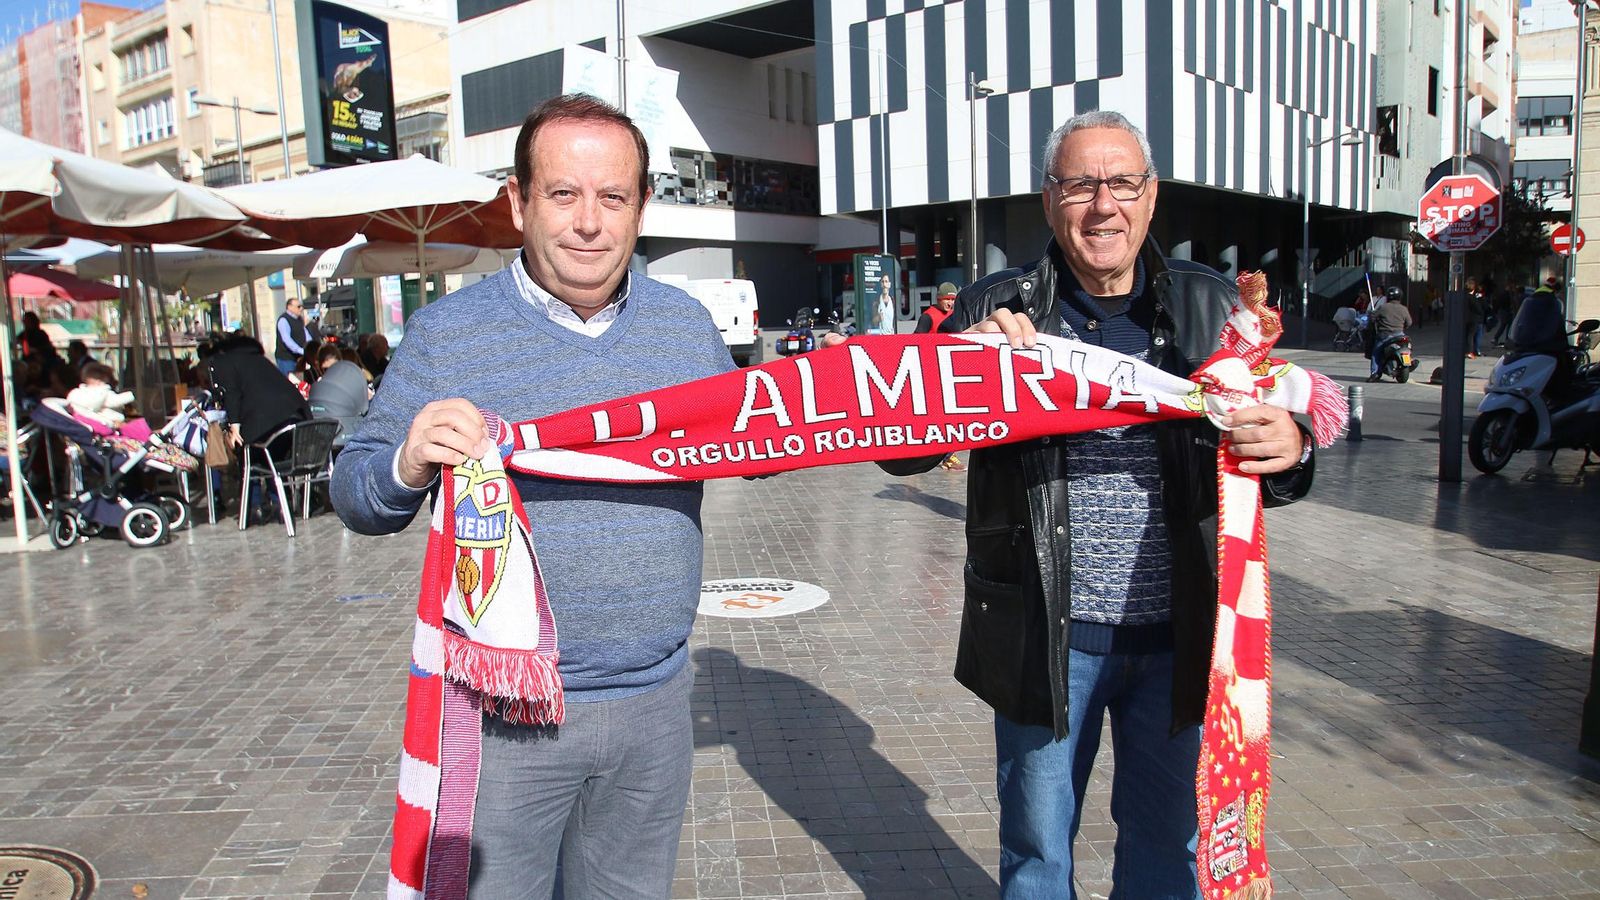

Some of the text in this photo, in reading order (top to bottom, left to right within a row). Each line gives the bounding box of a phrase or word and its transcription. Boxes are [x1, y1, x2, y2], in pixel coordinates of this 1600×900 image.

[332, 100, 357, 121] 15%
[1426, 204, 1494, 222] STOP
[732, 343, 1160, 433] ALMERIA
[651, 421, 1010, 468] ORGULLO ROJIBLANCO
[483, 482, 500, 506] D
